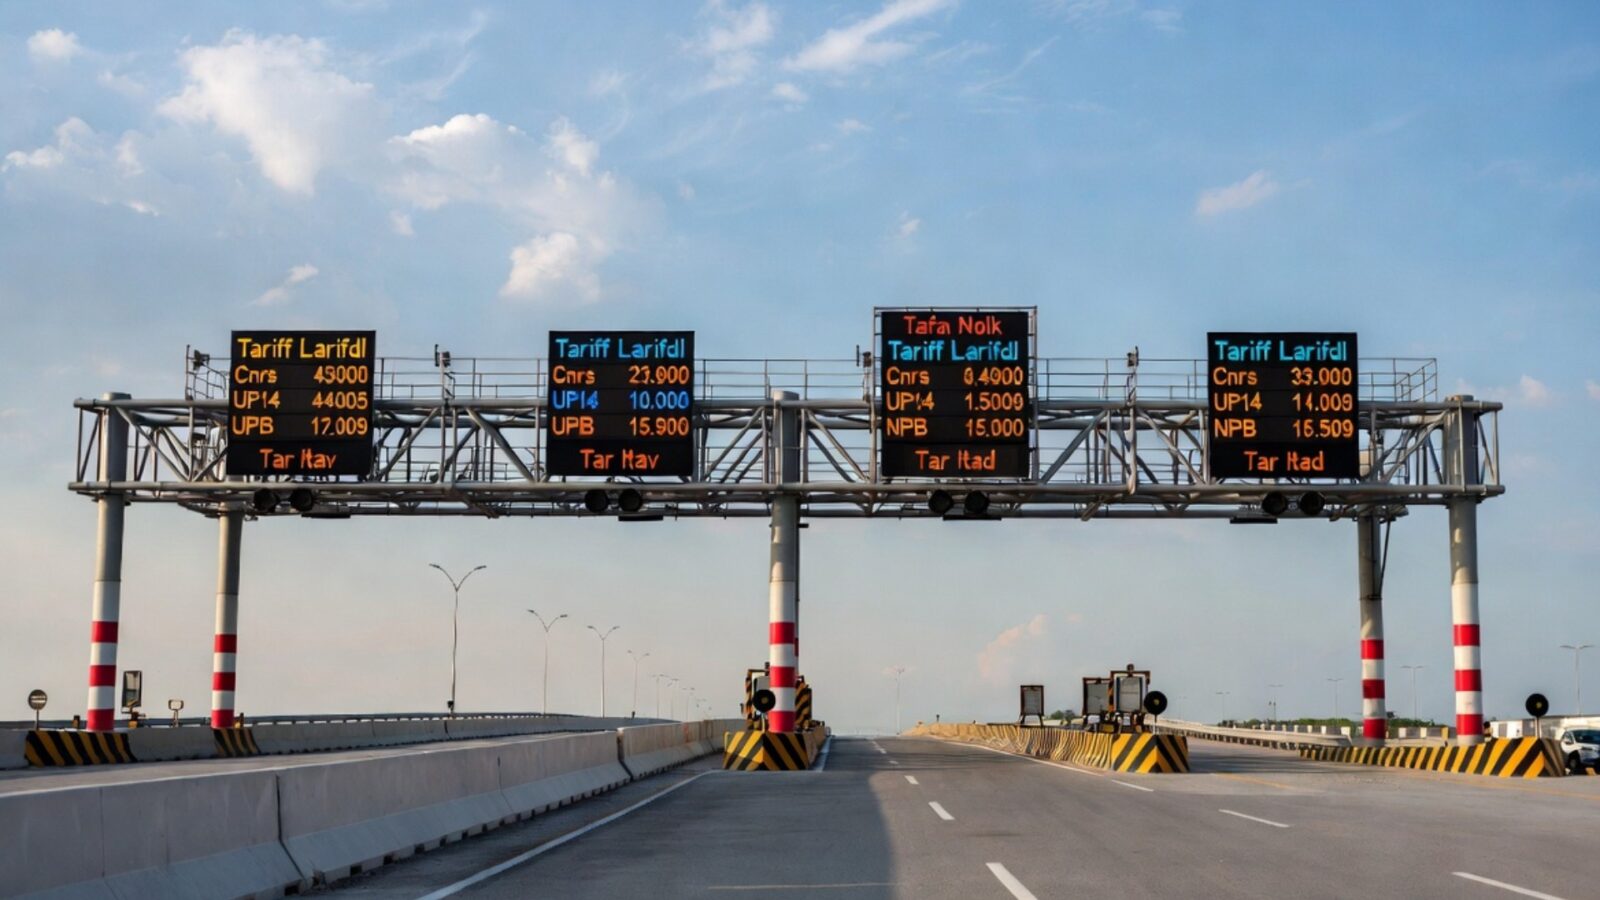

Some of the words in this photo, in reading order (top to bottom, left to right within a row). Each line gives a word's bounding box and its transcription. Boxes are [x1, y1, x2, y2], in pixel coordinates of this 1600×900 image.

[237, 336, 293, 359] Tariff
[555, 337, 611, 359] Tariff
[888, 340, 945, 361] Tariff
[1214, 340, 1272, 361] Tariff
[234, 364, 278, 384] Cnrs
[552, 364, 596, 385] Cnrs
[886, 366, 930, 386] Cnrs
[1213, 367, 1258, 386] Cnrs
[629, 390, 690, 410] 10.000
[1213, 392, 1263, 412] UP14
[232, 416, 274, 436] UPB
[552, 416, 595, 436] UPB
[629, 416, 690, 436] 15.900
[886, 417, 929, 437] NPB
[965, 417, 1024, 437] 15.000
[1214, 418, 1257, 438] NPB
[259, 448, 295, 469] Tar
[579, 448, 615, 470] Tar
[914, 450, 951, 471] Tar
[1243, 451, 1279, 472] Tar
